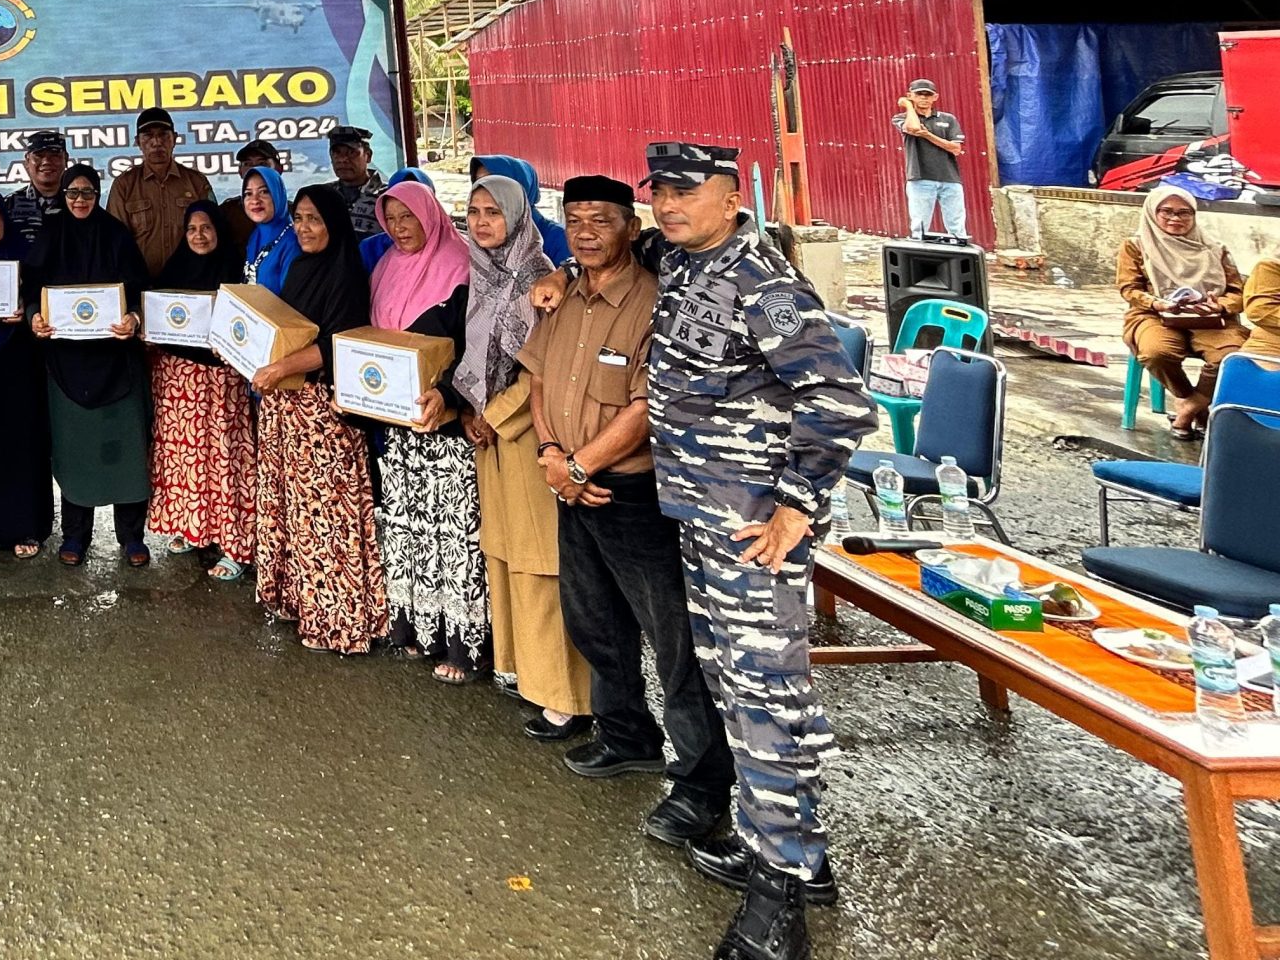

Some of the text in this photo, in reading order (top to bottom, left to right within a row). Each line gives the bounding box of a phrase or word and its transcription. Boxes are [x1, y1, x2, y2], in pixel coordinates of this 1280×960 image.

[30, 71, 330, 114] SEMBAKO
[66, 126, 127, 148] TNI
[191, 121, 249, 143] TA.
[257, 117, 337, 140] 2024
[683, 299, 725, 327] TNI AL
[965, 597, 989, 617] PASEO
[1003, 604, 1032, 614] PASEO
